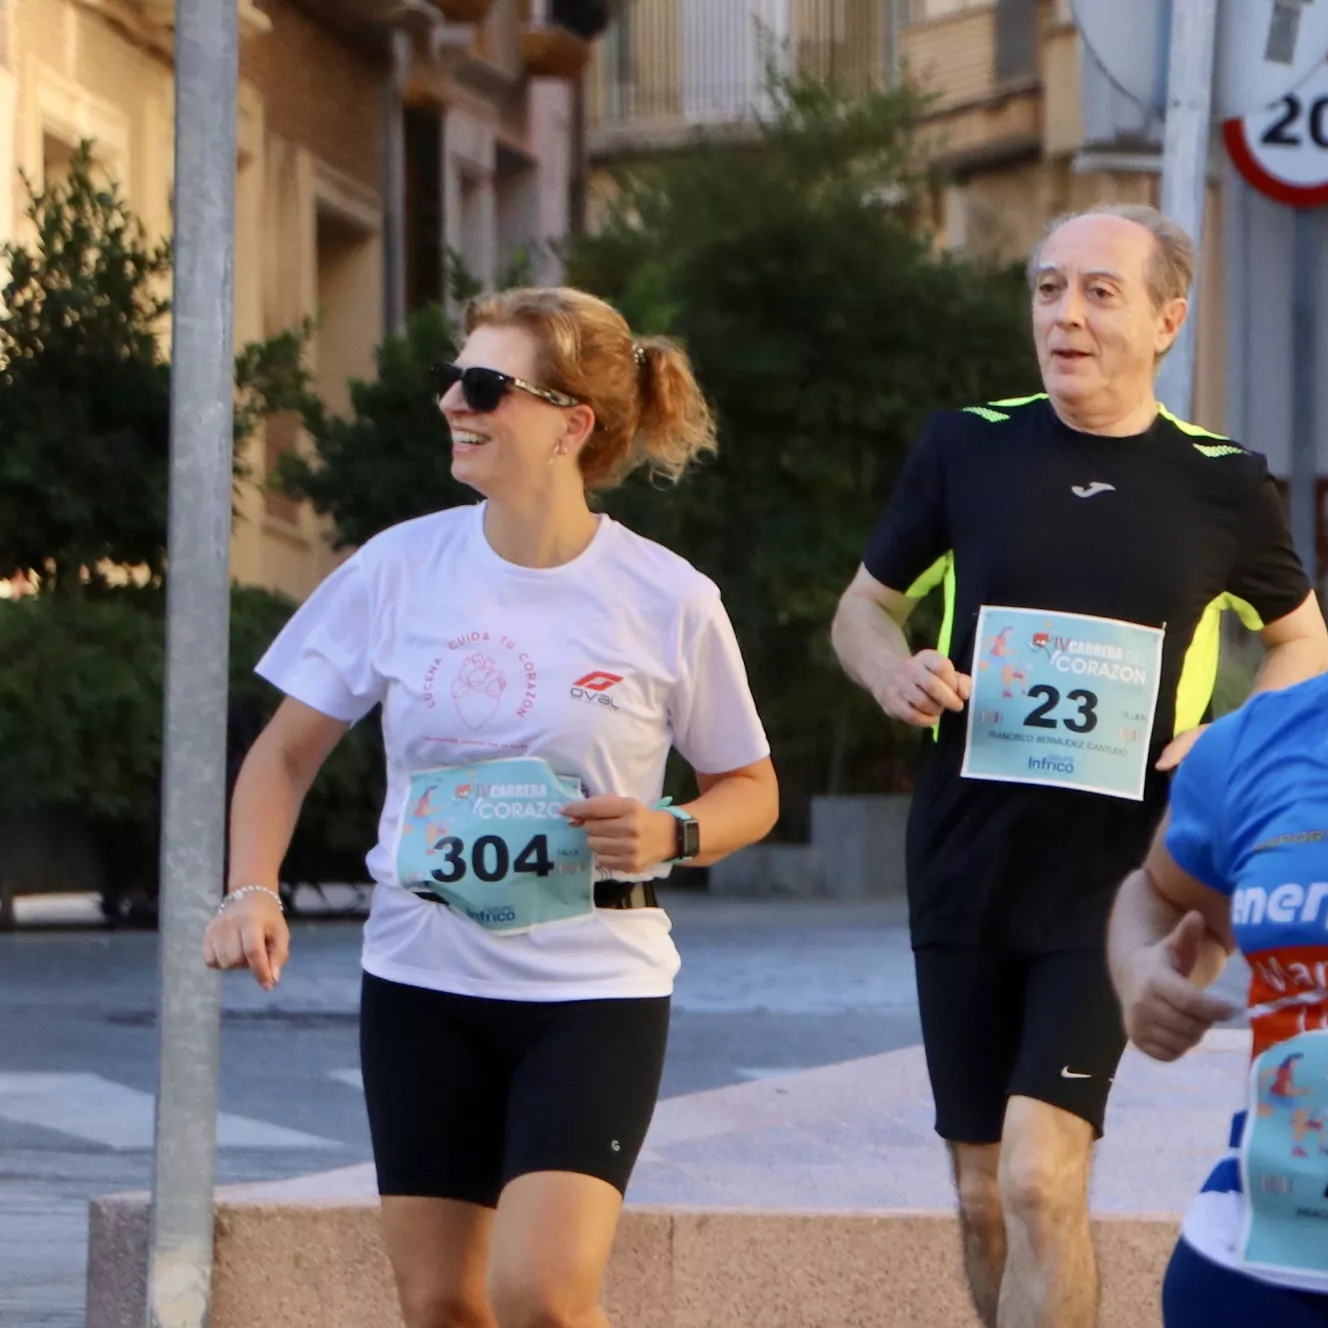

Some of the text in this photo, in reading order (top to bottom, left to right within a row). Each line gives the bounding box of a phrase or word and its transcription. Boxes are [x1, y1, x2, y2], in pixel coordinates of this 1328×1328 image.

[1023, 684, 1098, 733] 23
[479, 802, 565, 819] CORAZO
[431, 834, 555, 883] 304
